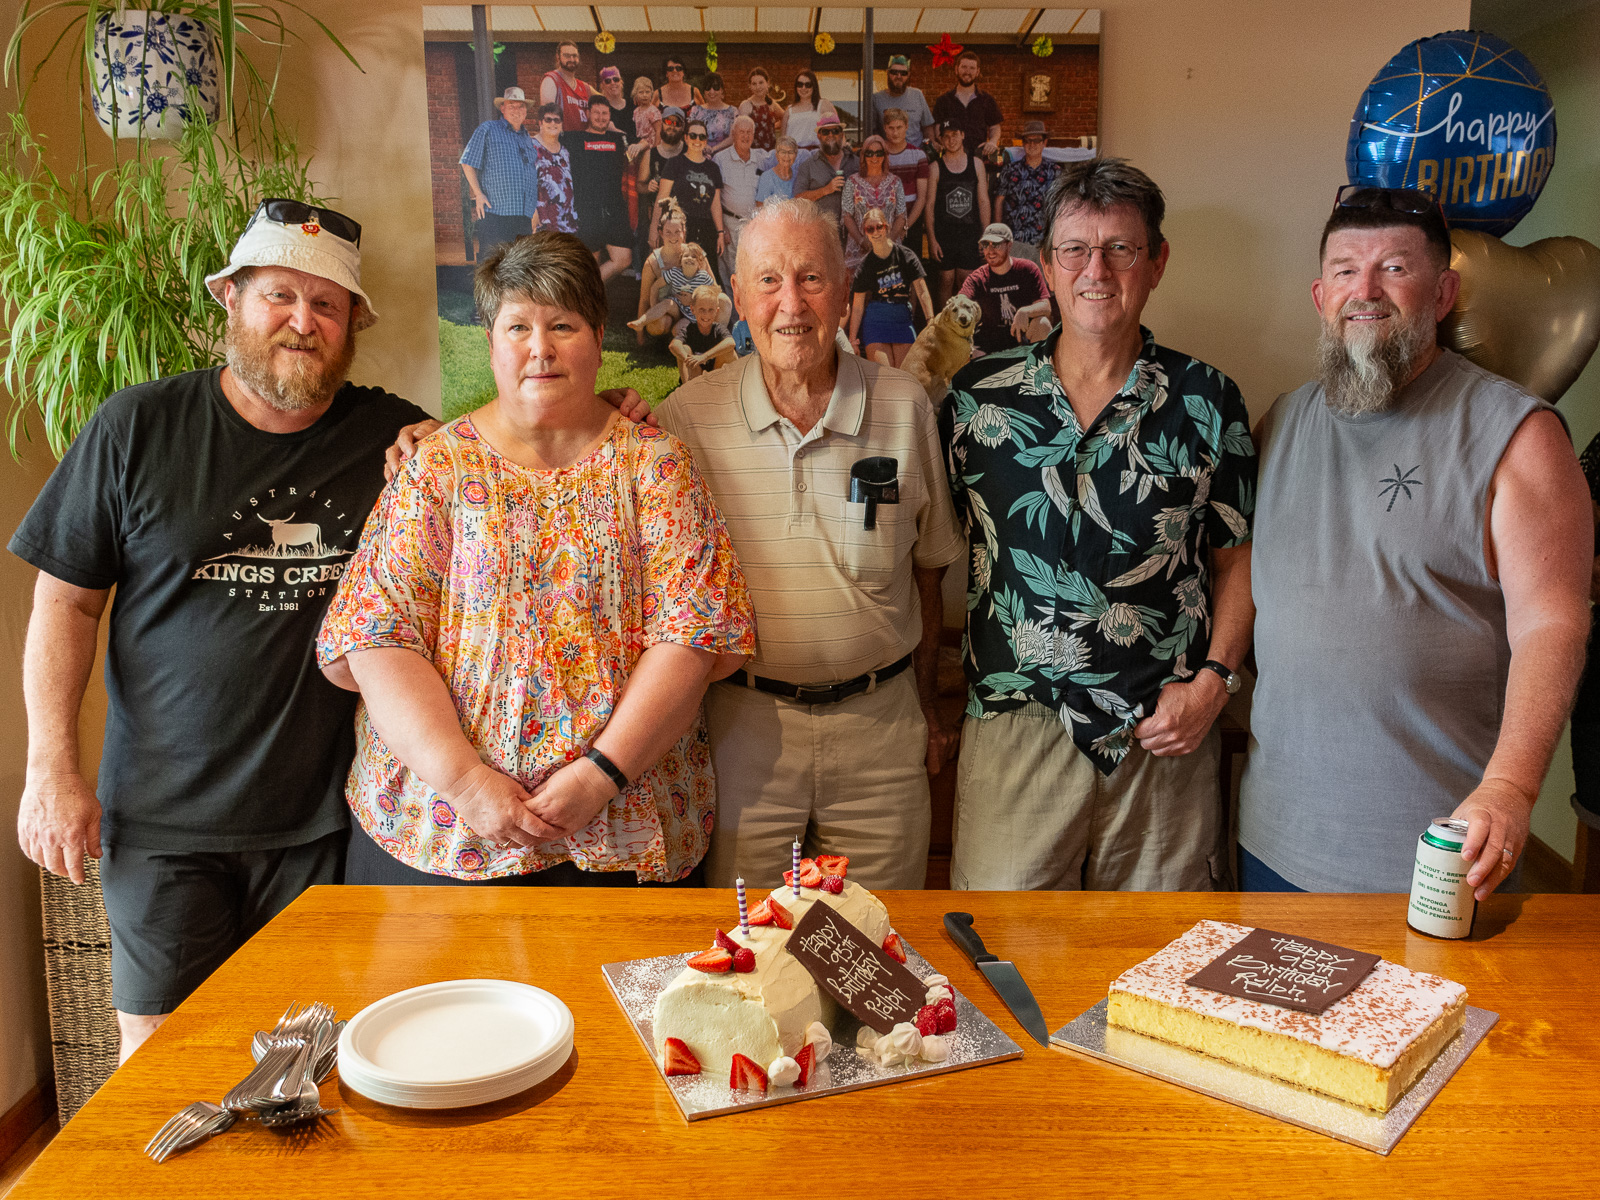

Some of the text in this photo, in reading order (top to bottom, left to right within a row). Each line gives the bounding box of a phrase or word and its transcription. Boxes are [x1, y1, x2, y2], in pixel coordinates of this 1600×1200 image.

[222, 487, 353, 541] AUSTRALIA
[191, 563, 275, 584] KINGS
[228, 587, 327, 600] STATION
[258, 602, 299, 612] Est. 1981
[1418, 868, 1460, 884] WATER LAGER
[1423, 864, 1440, 874] STOUT
[1429, 911, 1463, 921] PENINSULA
[799, 915, 842, 964] Happy
[830, 935, 860, 963] 95th
[1270, 937, 1355, 965] Happy
[1225, 954, 1343, 994] Birthday
[1279, 954, 1348, 976] 95th
[863, 982, 912, 1020] Ralph
